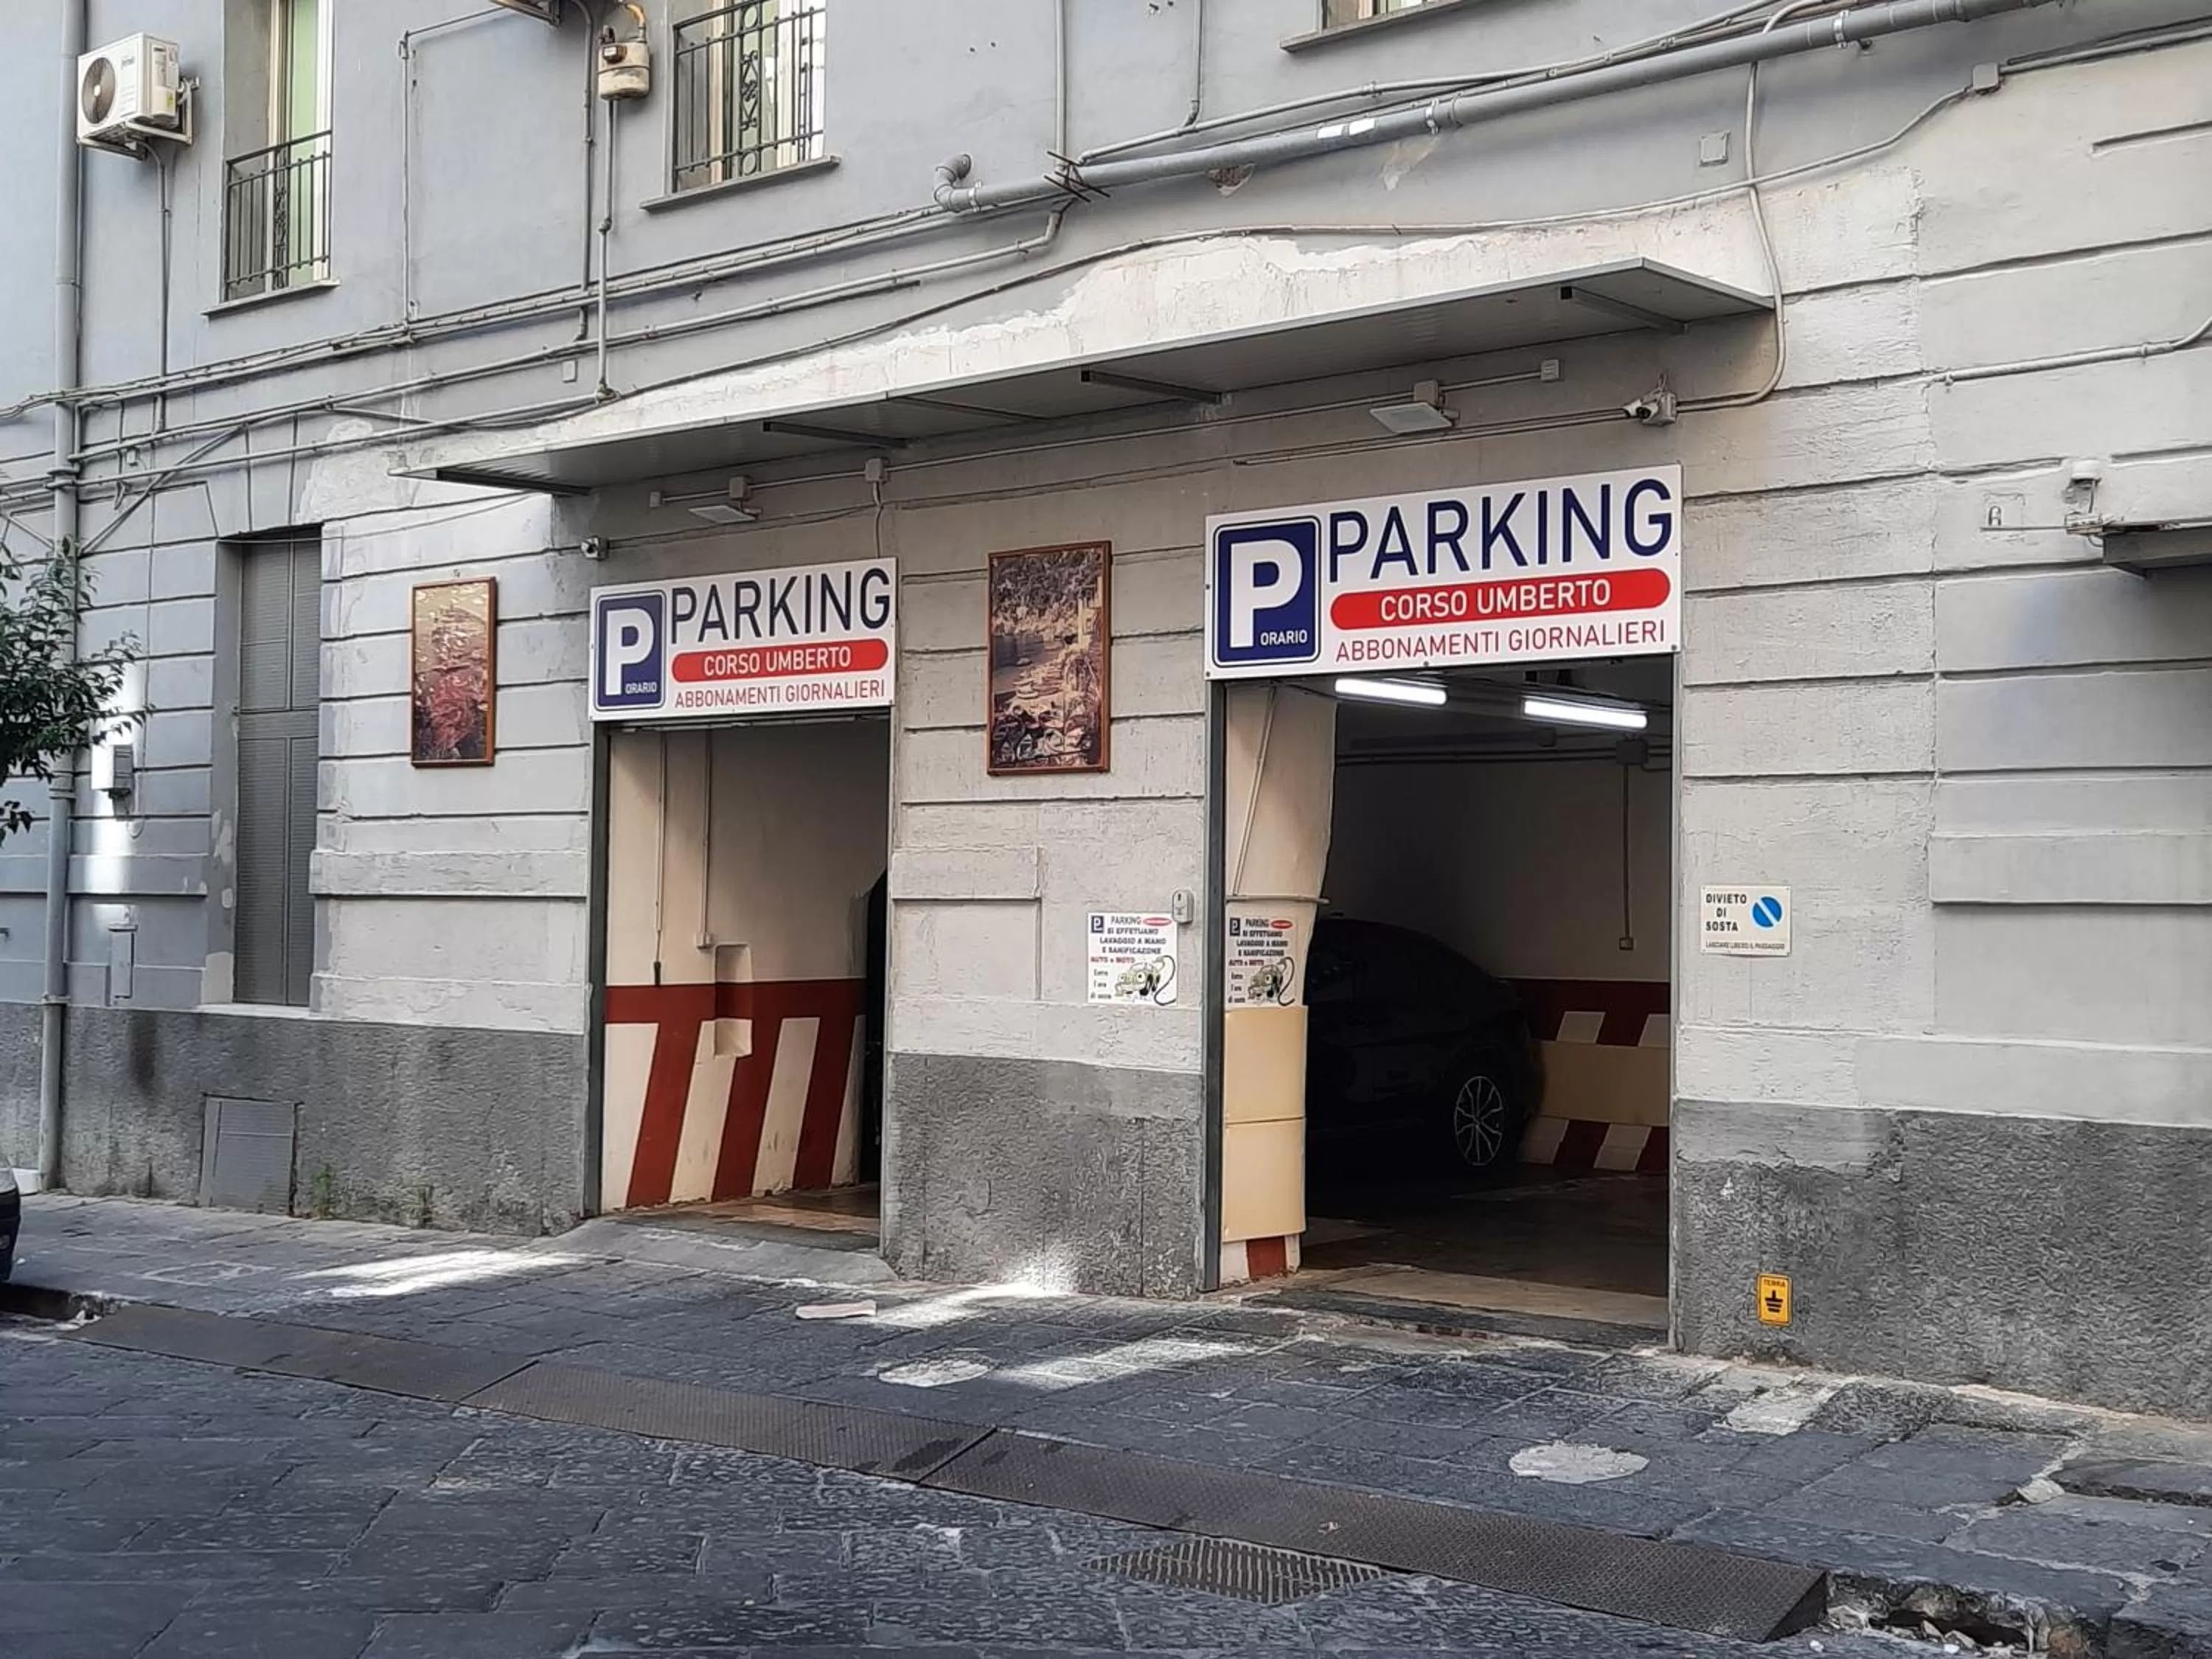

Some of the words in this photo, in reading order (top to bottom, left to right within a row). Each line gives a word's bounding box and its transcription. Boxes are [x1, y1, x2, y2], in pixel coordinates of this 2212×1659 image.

[1329, 479, 1672, 582] PARKING
[671, 568, 890, 644] PARKING
[1230, 540, 1304, 648] P
[1380, 591, 1467, 622] CORSO
[1477, 580, 1610, 614] UMBERTO
[605, 608, 655, 696] P
[1260, 630, 1308, 646] ORARIO
[1336, 632, 1499, 662] ABBONAMENTI
[1509, 620, 1665, 650] GIORNALIERI
[704, 653, 759, 676] CORSO
[766, 646, 850, 672] UMBERTO
[625, 682, 656, 694] ORARIO
[675, 686, 781, 708] ABBONAMENTI
[785, 679, 884, 702] GIORNALIERI
[1705, 893, 1747, 904] DIVIETO
[1716, 908, 1727, 917] DI
[1110, 916, 1141, 925] PARKING
[1245, 919, 1269, 928] PARKING
[1705, 921, 1739, 931] SOSTA
